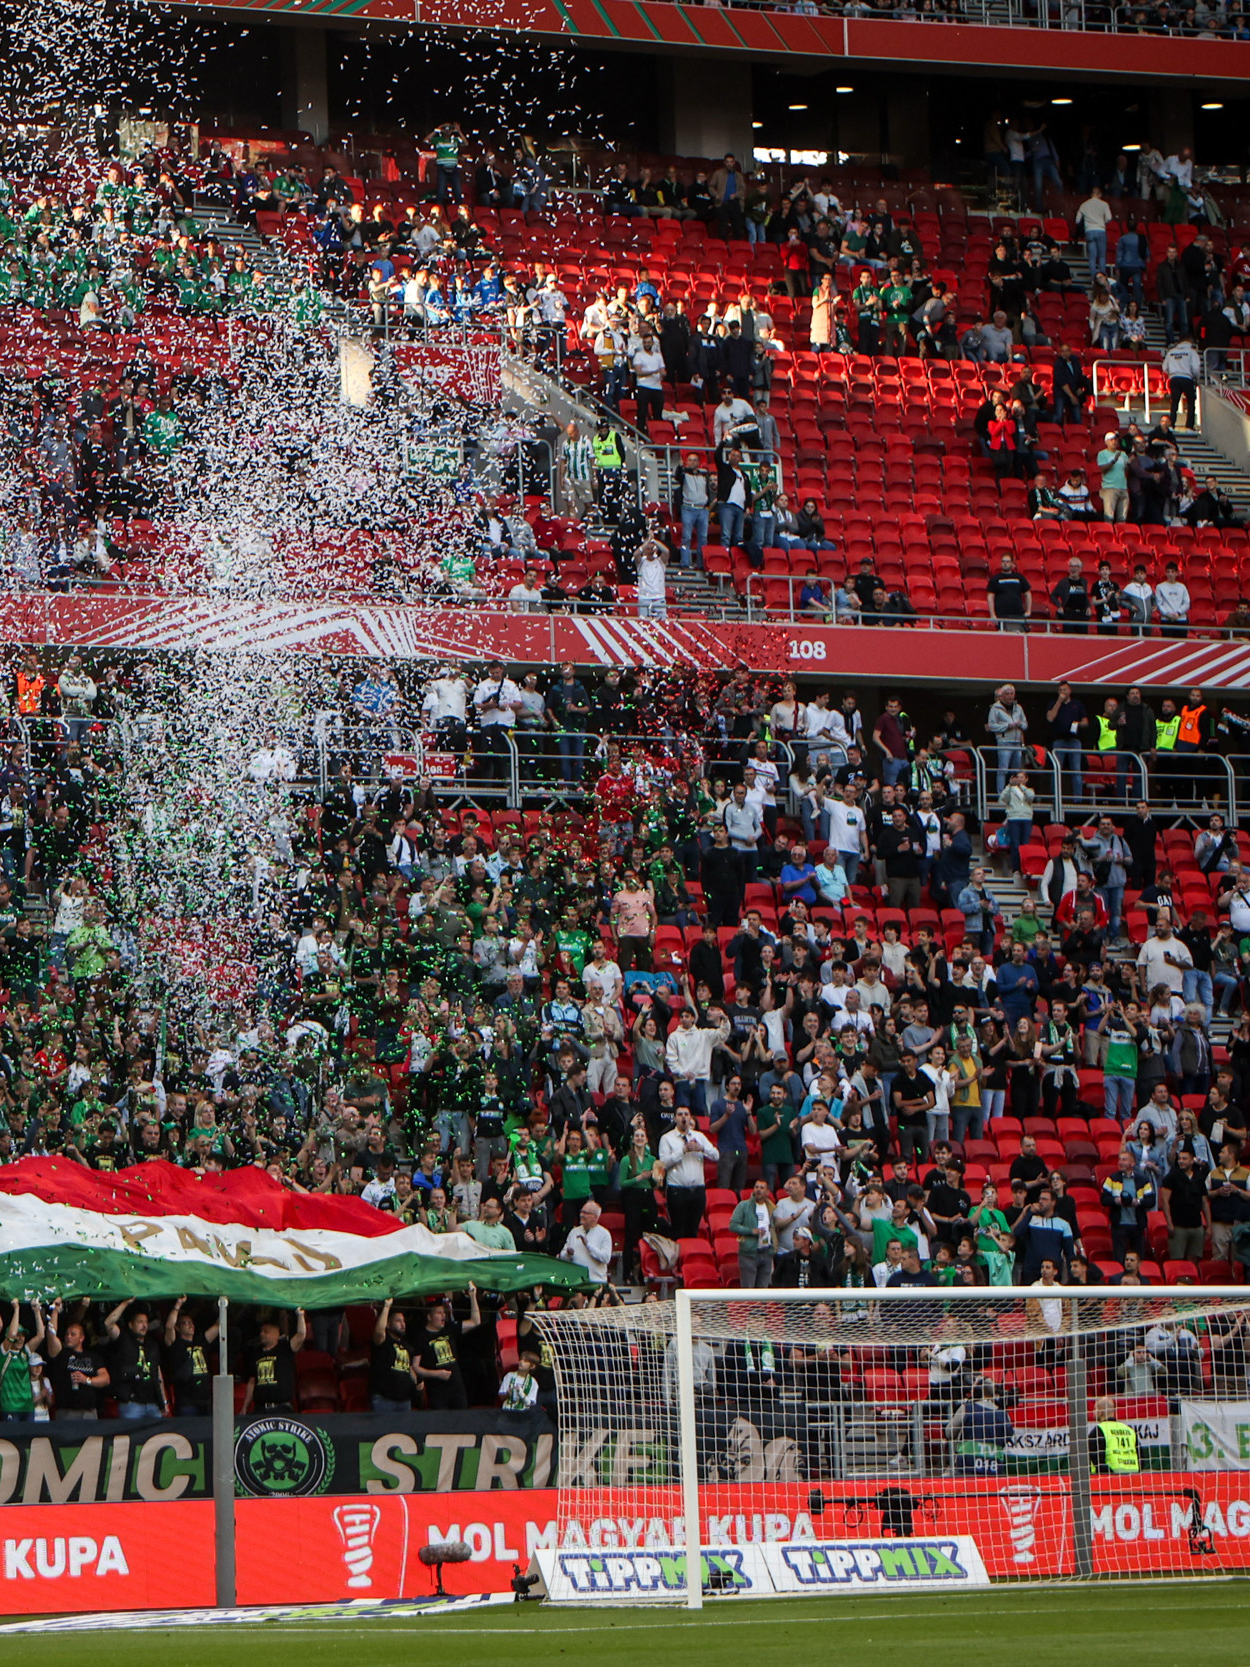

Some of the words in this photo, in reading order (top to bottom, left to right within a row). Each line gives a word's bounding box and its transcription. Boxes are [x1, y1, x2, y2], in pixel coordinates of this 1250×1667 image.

[789, 640, 827, 660] 108
[244, 1421, 277, 1442] ATOMIC
[278, 1421, 315, 1444] STRIKE
[1128, 1423, 1159, 1439] KAJ
[367, 1430, 657, 1493] STRIKE
[708, 1512, 816, 1546] KUPA
[1089, 1503, 1164, 1541] MOL
[4, 1535, 129, 1579] KUPA
